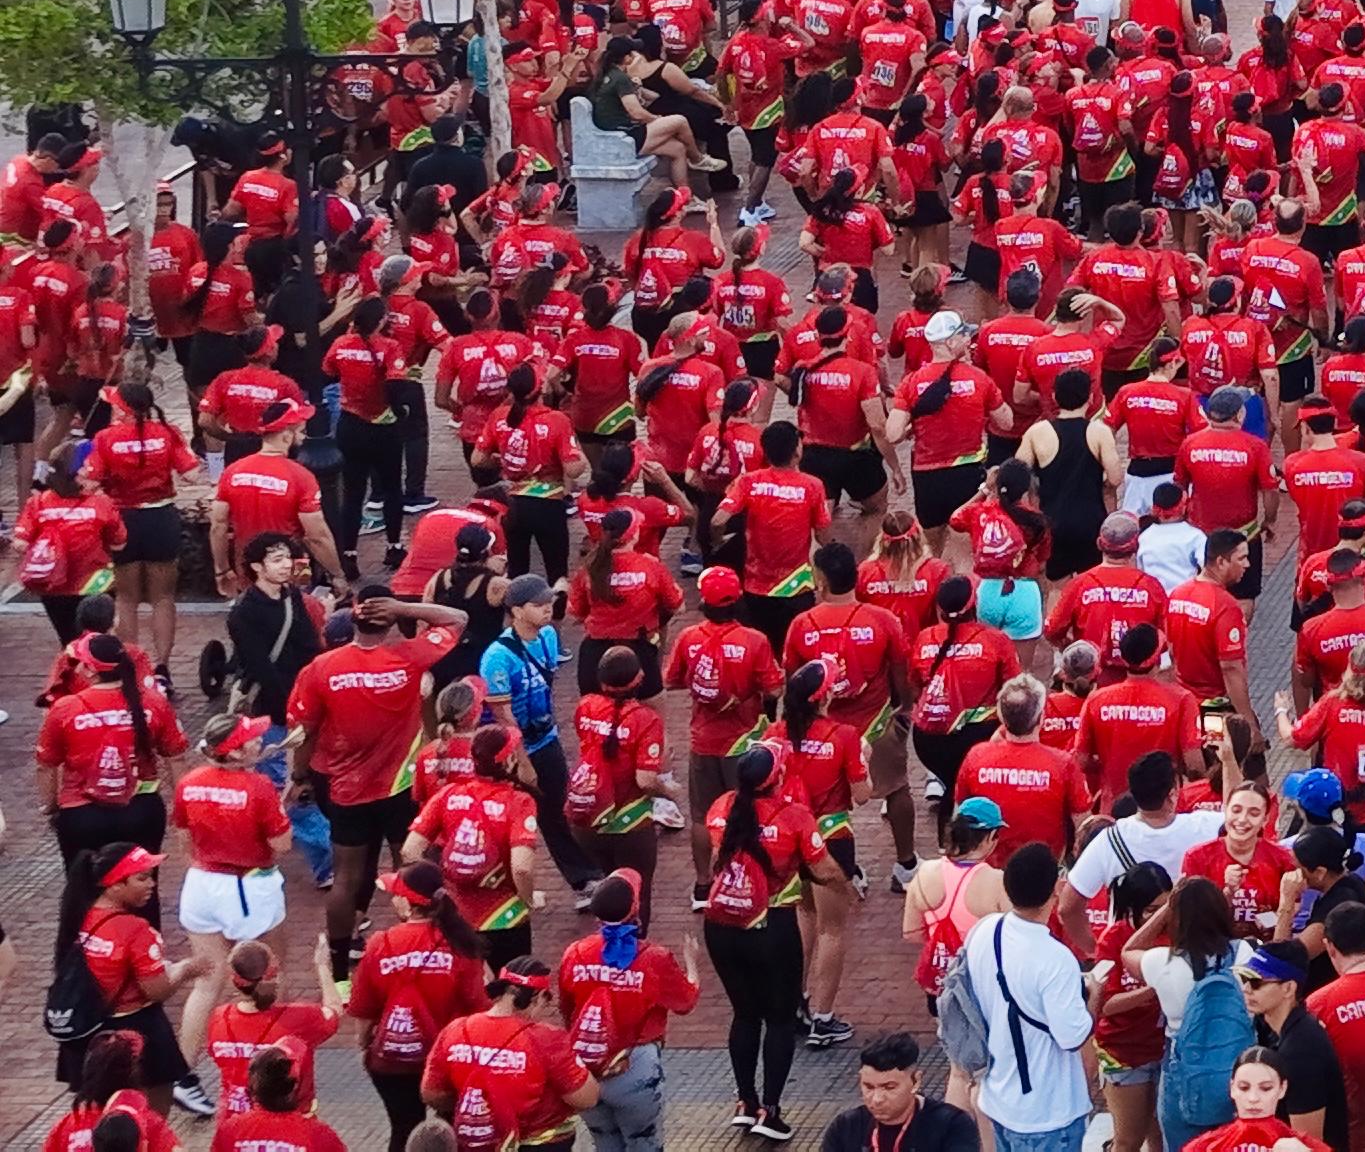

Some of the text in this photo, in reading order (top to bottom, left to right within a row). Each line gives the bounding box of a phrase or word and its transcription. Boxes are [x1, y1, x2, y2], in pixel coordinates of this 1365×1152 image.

[330, 670, 407, 690] CARTAGENA
[1101, 706, 1165, 721] CARTAGENA
[979, 768, 1050, 785] CARTAGENA
